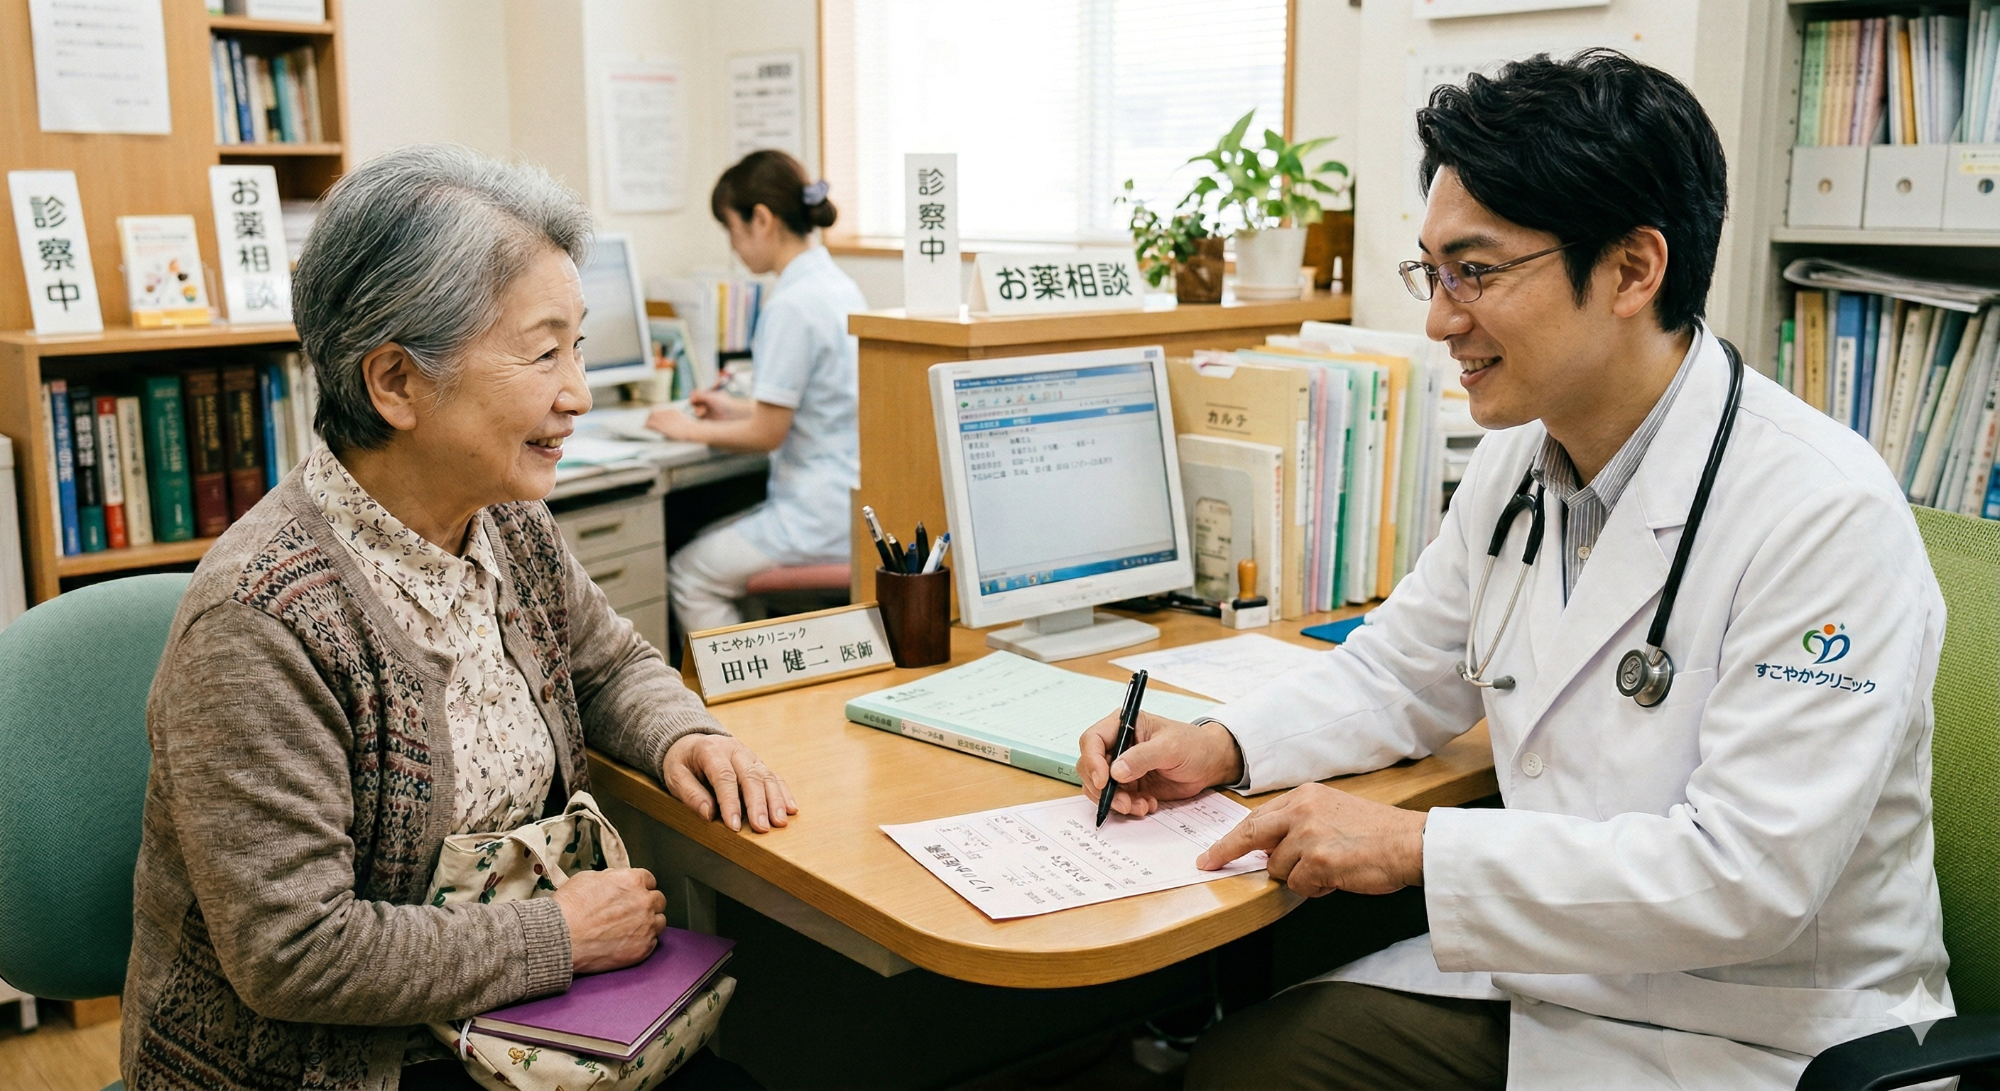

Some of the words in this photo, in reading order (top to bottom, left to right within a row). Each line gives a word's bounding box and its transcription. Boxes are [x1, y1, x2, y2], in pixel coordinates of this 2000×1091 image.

[917, 168, 945, 263] 診察中
[29, 195, 81, 312] 診察中
[230, 179, 279, 310] お薬相談
[996, 261, 1133, 301] お薬相談
[708, 626, 807, 655] すこやかクリニック
[721, 654, 769, 684] 田中
[782, 644, 829, 673] 健二
[839, 639, 874, 663] 医師
[1754, 662, 1876, 694] すこやかクリニック
